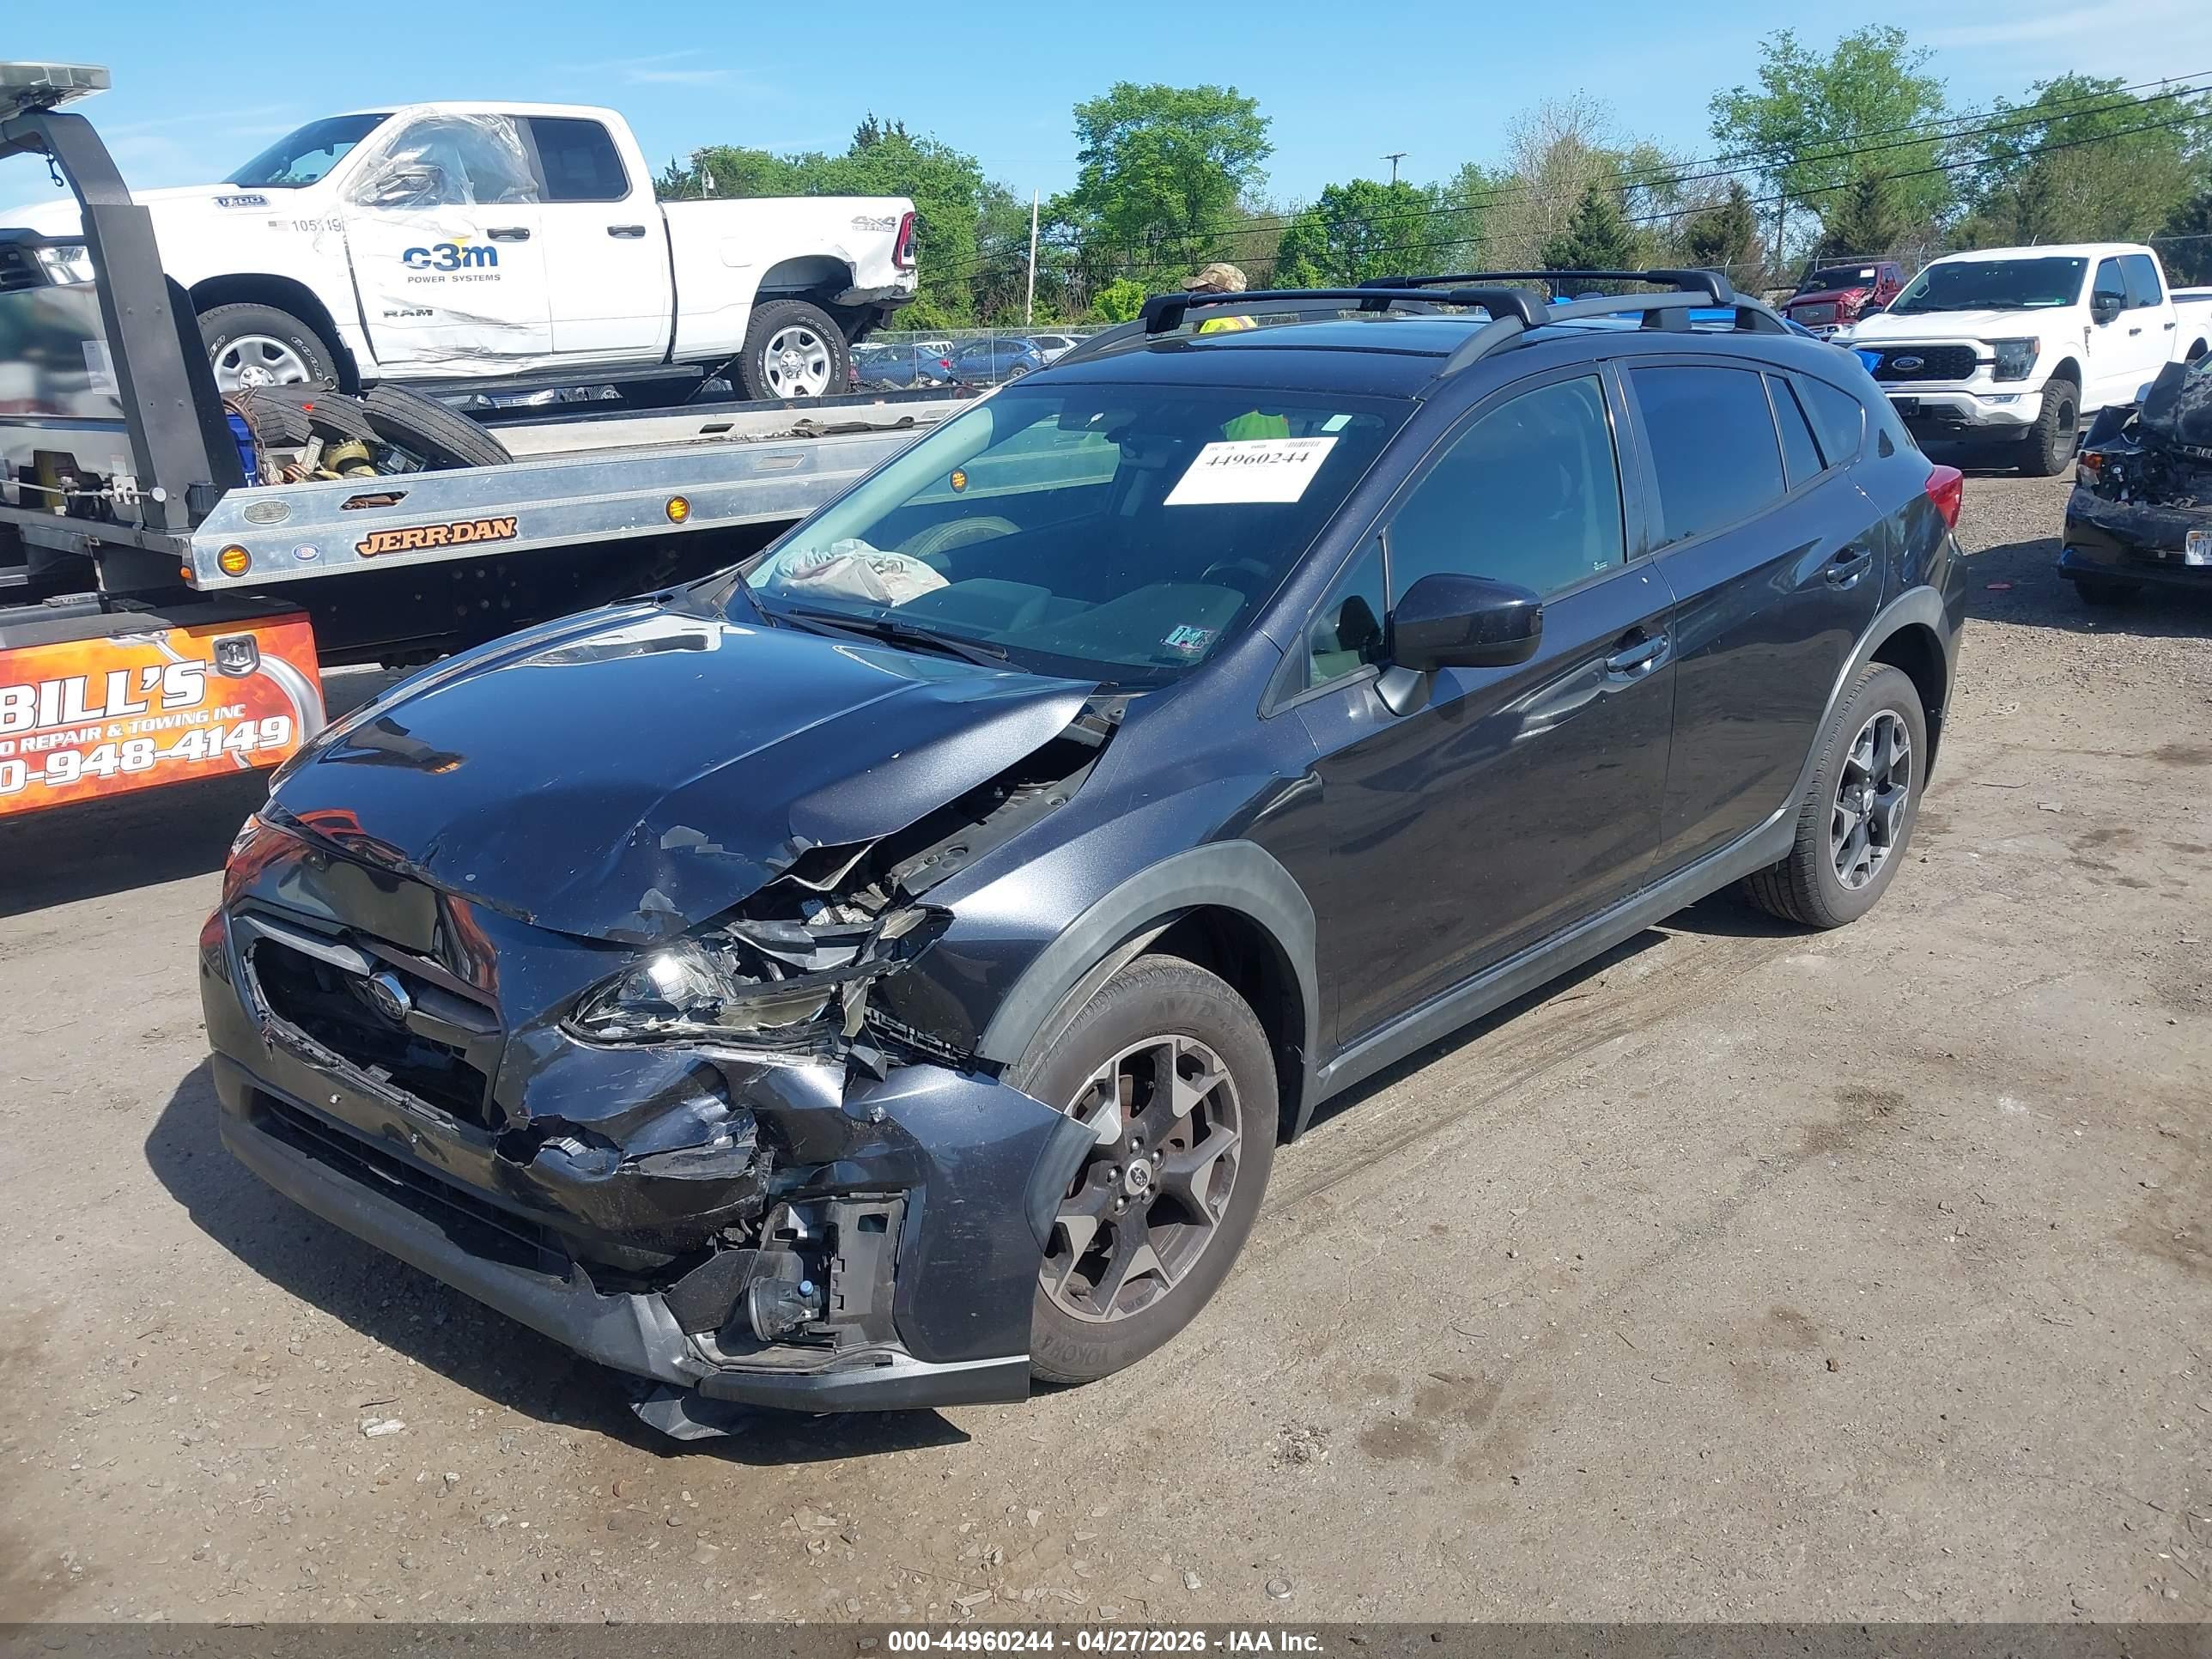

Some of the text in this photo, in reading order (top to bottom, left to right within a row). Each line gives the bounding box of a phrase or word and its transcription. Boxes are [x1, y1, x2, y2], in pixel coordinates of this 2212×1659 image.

[403, 243, 498, 271] c3m
[452, 274, 501, 283] SYSTEMS
[383, 309, 434, 318] RAM
[797, 316, 842, 381] GOODYEAR
[1206, 452, 1310, 466] 44960244
[356, 518, 516, 556] JERR-DAN
[0, 659, 207, 734] BILL'S
[20, 727, 102, 752] REPAIR
[106, 724, 124, 738] &
[129, 709, 210, 734] TOWING
[213, 704, 246, 720] INC
